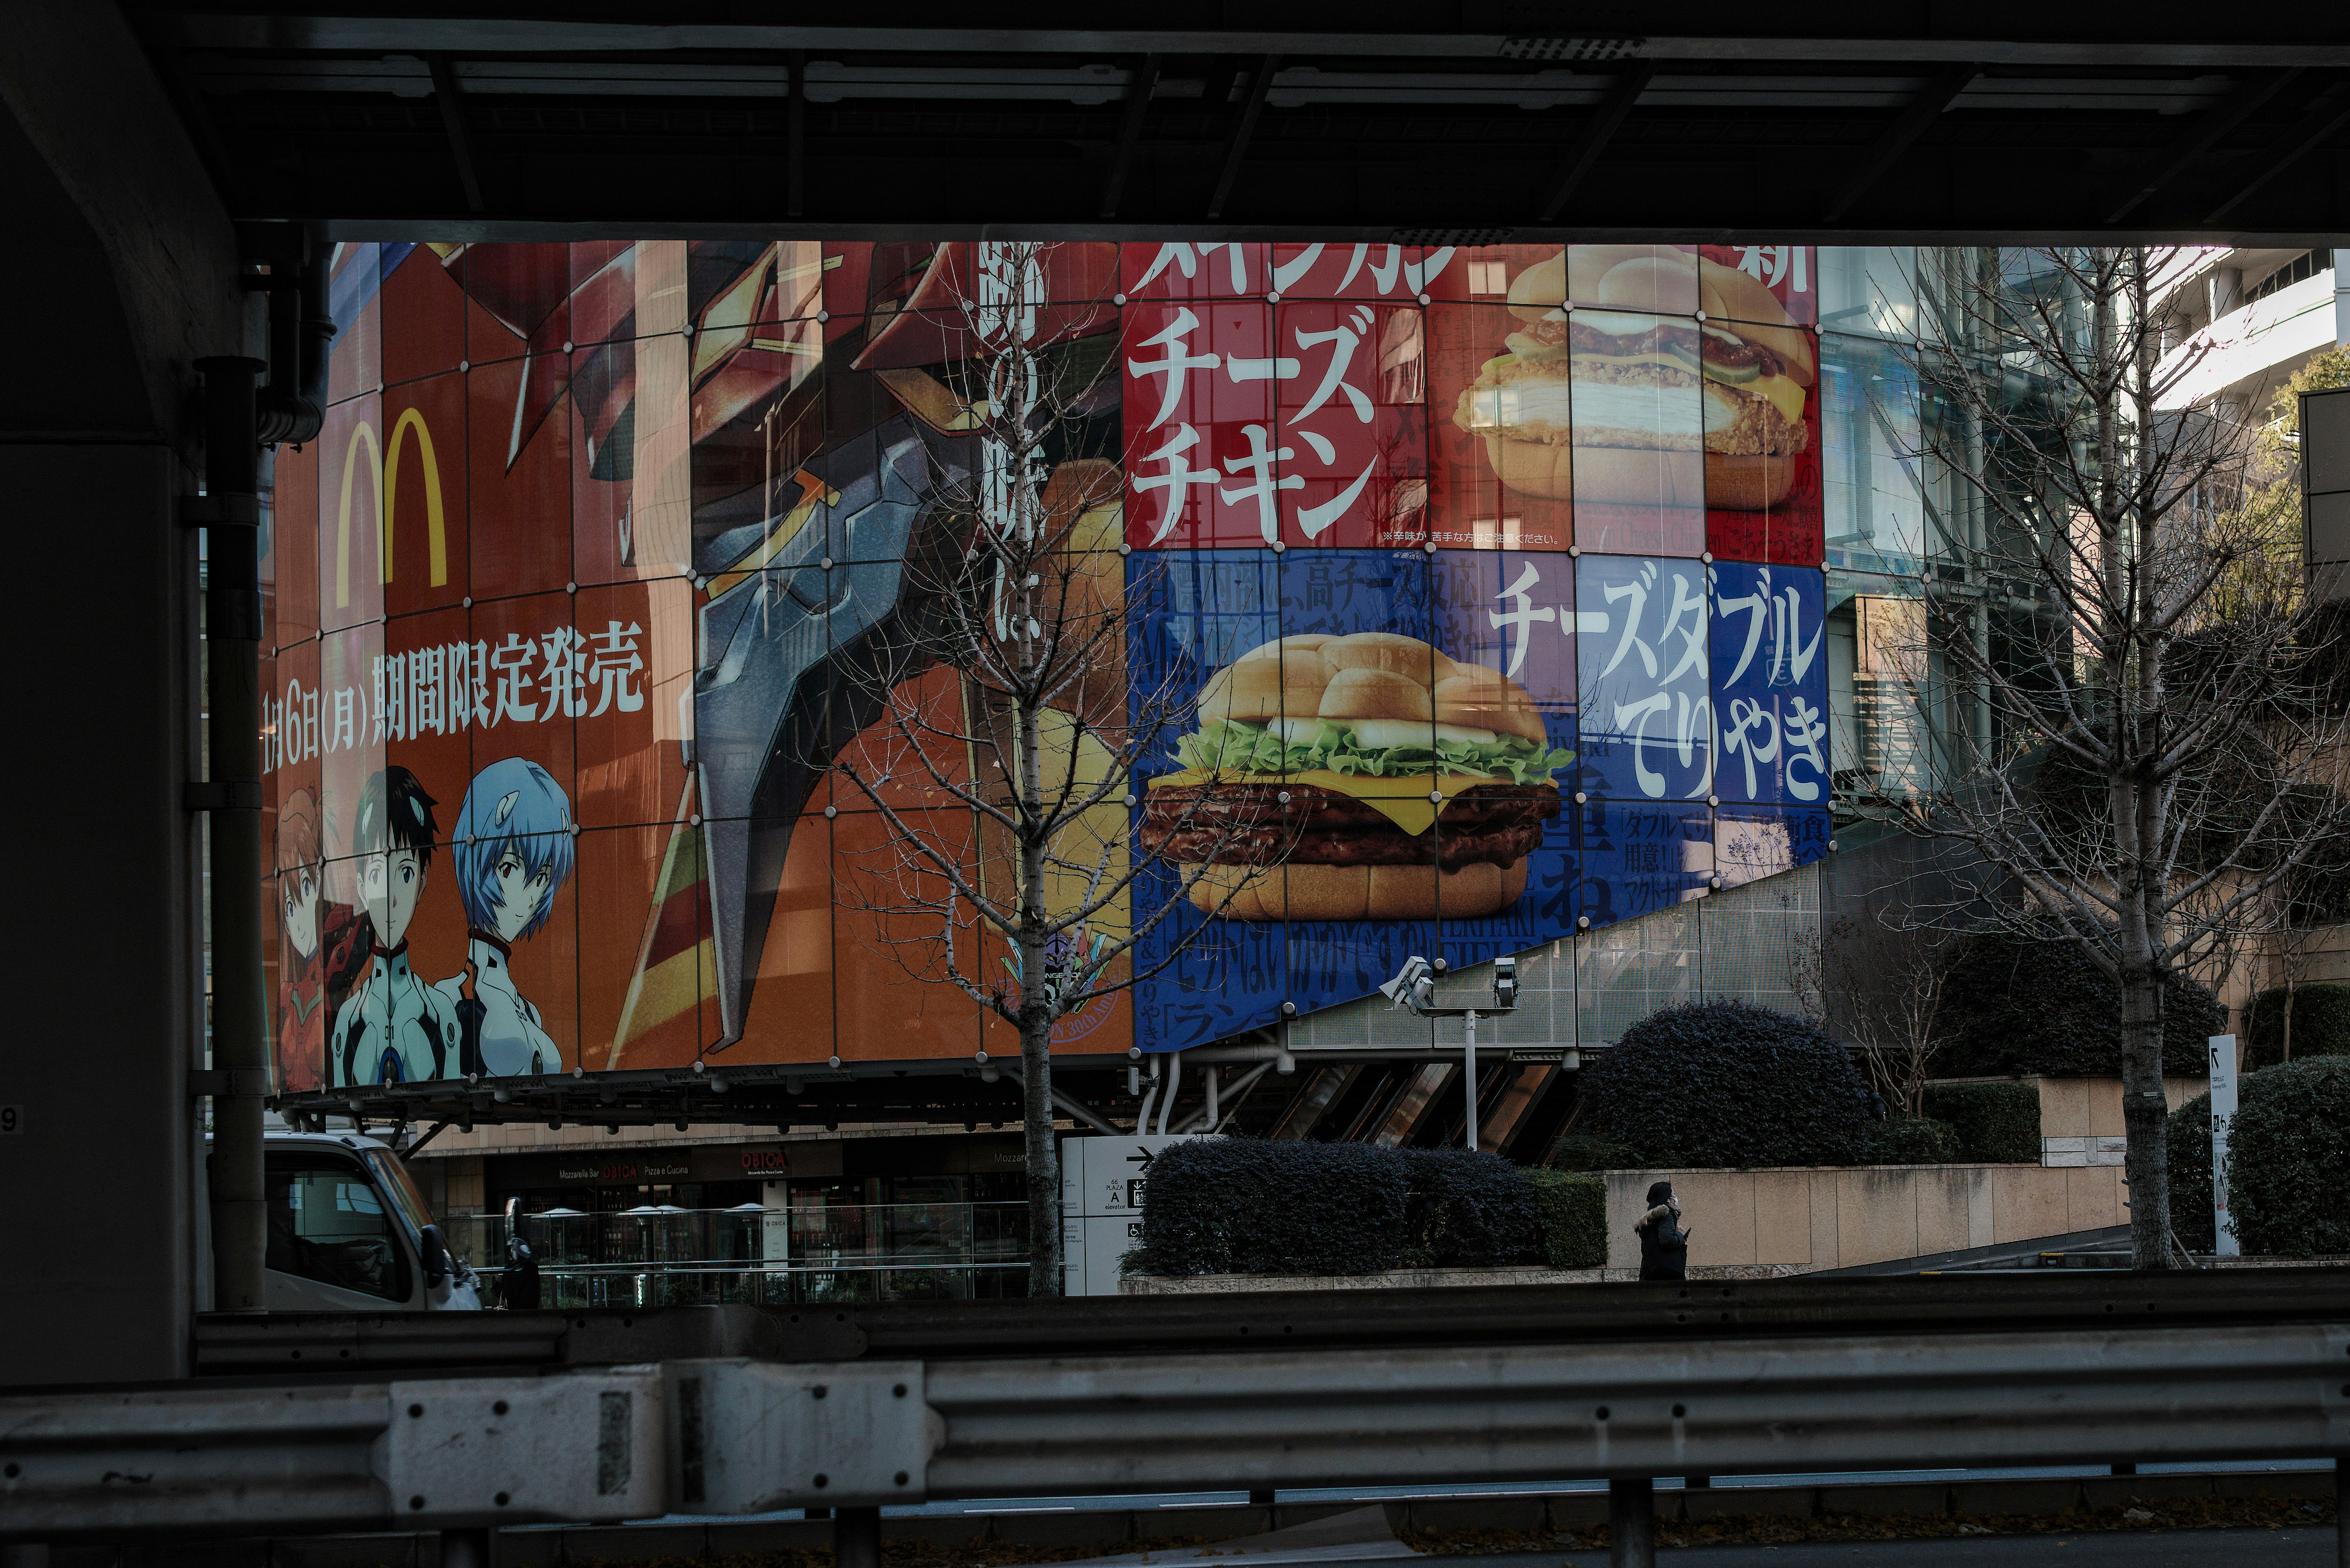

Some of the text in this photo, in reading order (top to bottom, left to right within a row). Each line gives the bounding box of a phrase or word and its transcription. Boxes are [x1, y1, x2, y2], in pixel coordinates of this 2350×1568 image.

[1128, 305, 1375, 433] チーズ
[1132, 422, 1378, 548] チキン
[1489, 561, 1823, 691] チーズダブル
[372, 621, 644, 747] 期間限定発売
[1614, 691, 1826, 801] てりやき
[1, 1108, 17, 1131] 9
[559, 1169, 588, 1179] Mozzarella
[589, 1168, 600, 1178] Bar
[644, 1166, 660, 1175] Pizza
[666, 1164, 689, 1175] Cucina
[994, 1153, 1027, 1162] Mozzare
[1111, 1192, 1120, 1202] A
